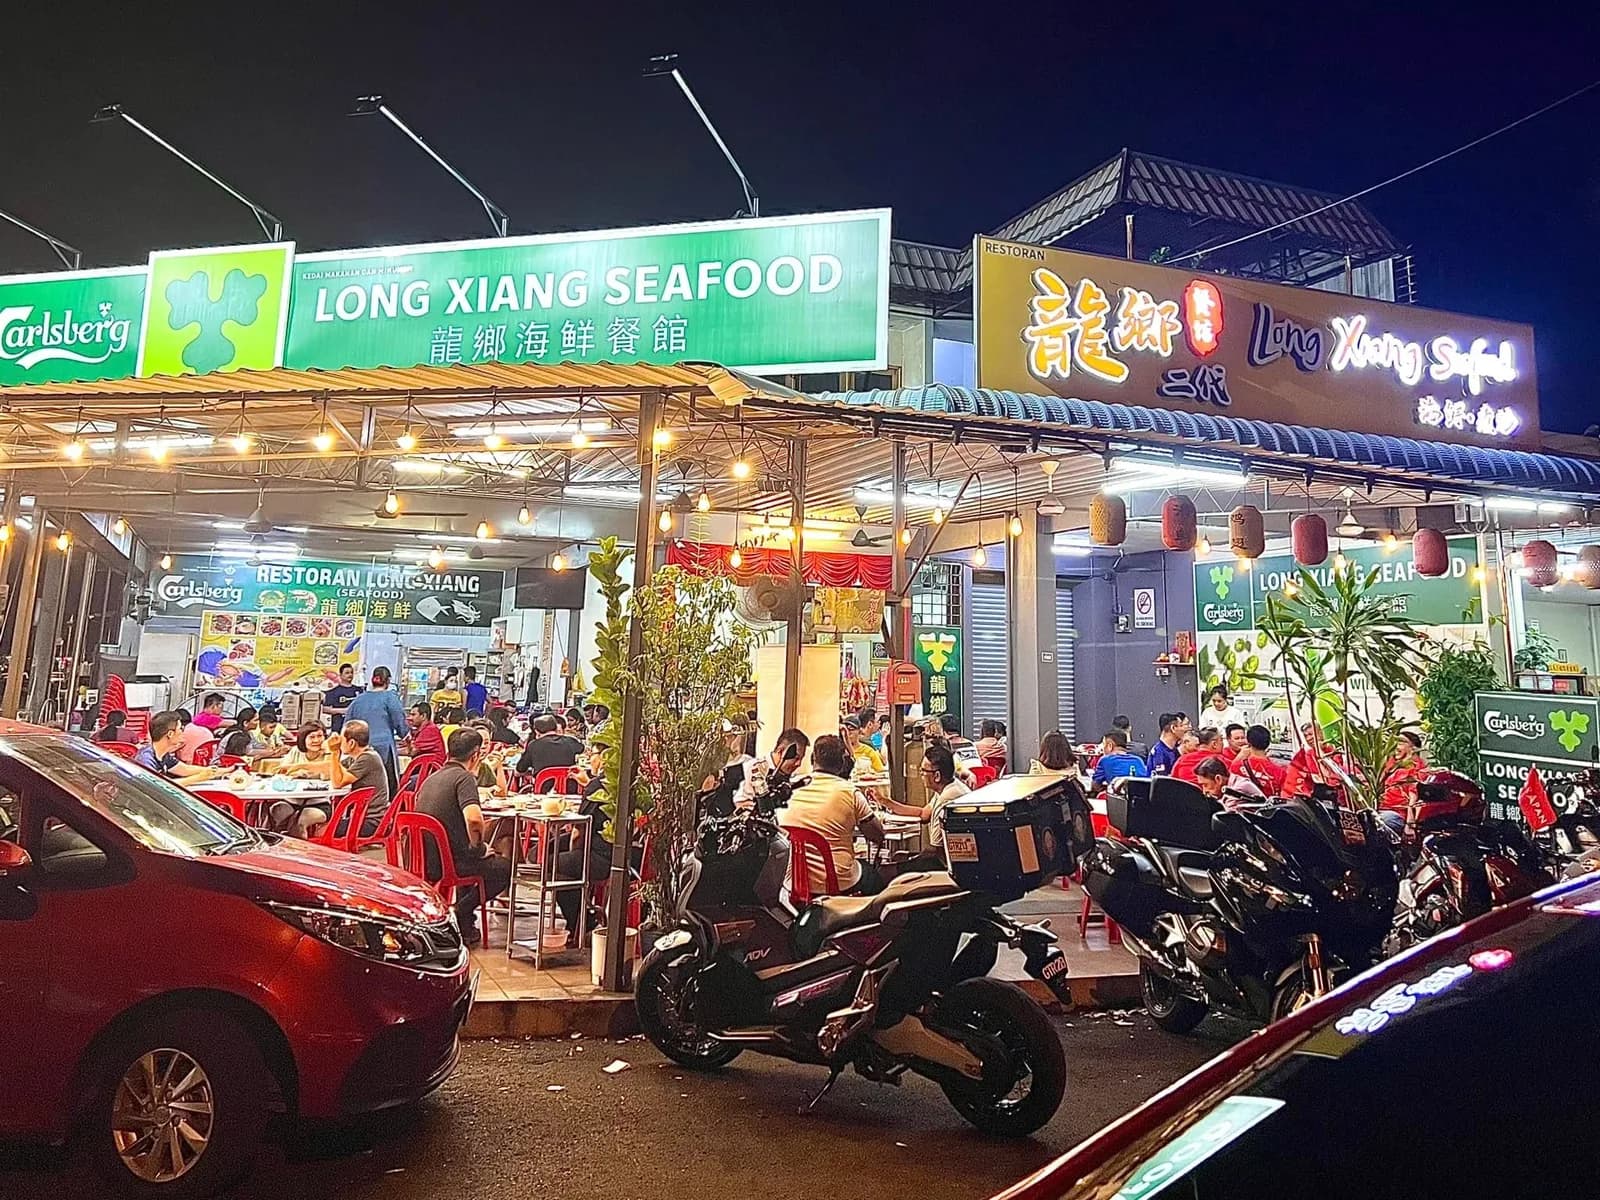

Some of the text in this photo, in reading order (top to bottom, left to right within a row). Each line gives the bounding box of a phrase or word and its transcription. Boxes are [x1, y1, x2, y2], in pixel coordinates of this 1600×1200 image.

[984, 241, 1046, 262] RESTORAN
[303, 271, 323, 280] KEDAI
[325, 269, 361, 279] MAKANAN
[379, 264, 414, 275] MINU
[314, 253, 844, 322] LONG XIANG SEAFOOD
[0, 303, 132, 364] Carlsberg
[1248, 302, 1325, 373] Long
[256, 566, 361, 587] RESTORAN
[1371, 557, 1467, 584] SEAFD
[157, 575, 243, 606] Carlsberg
[1203, 602, 1244, 625] Carlsberg
[1483, 710, 1546, 738] Carlsberg
[1485, 762, 1529, 781] LONG
